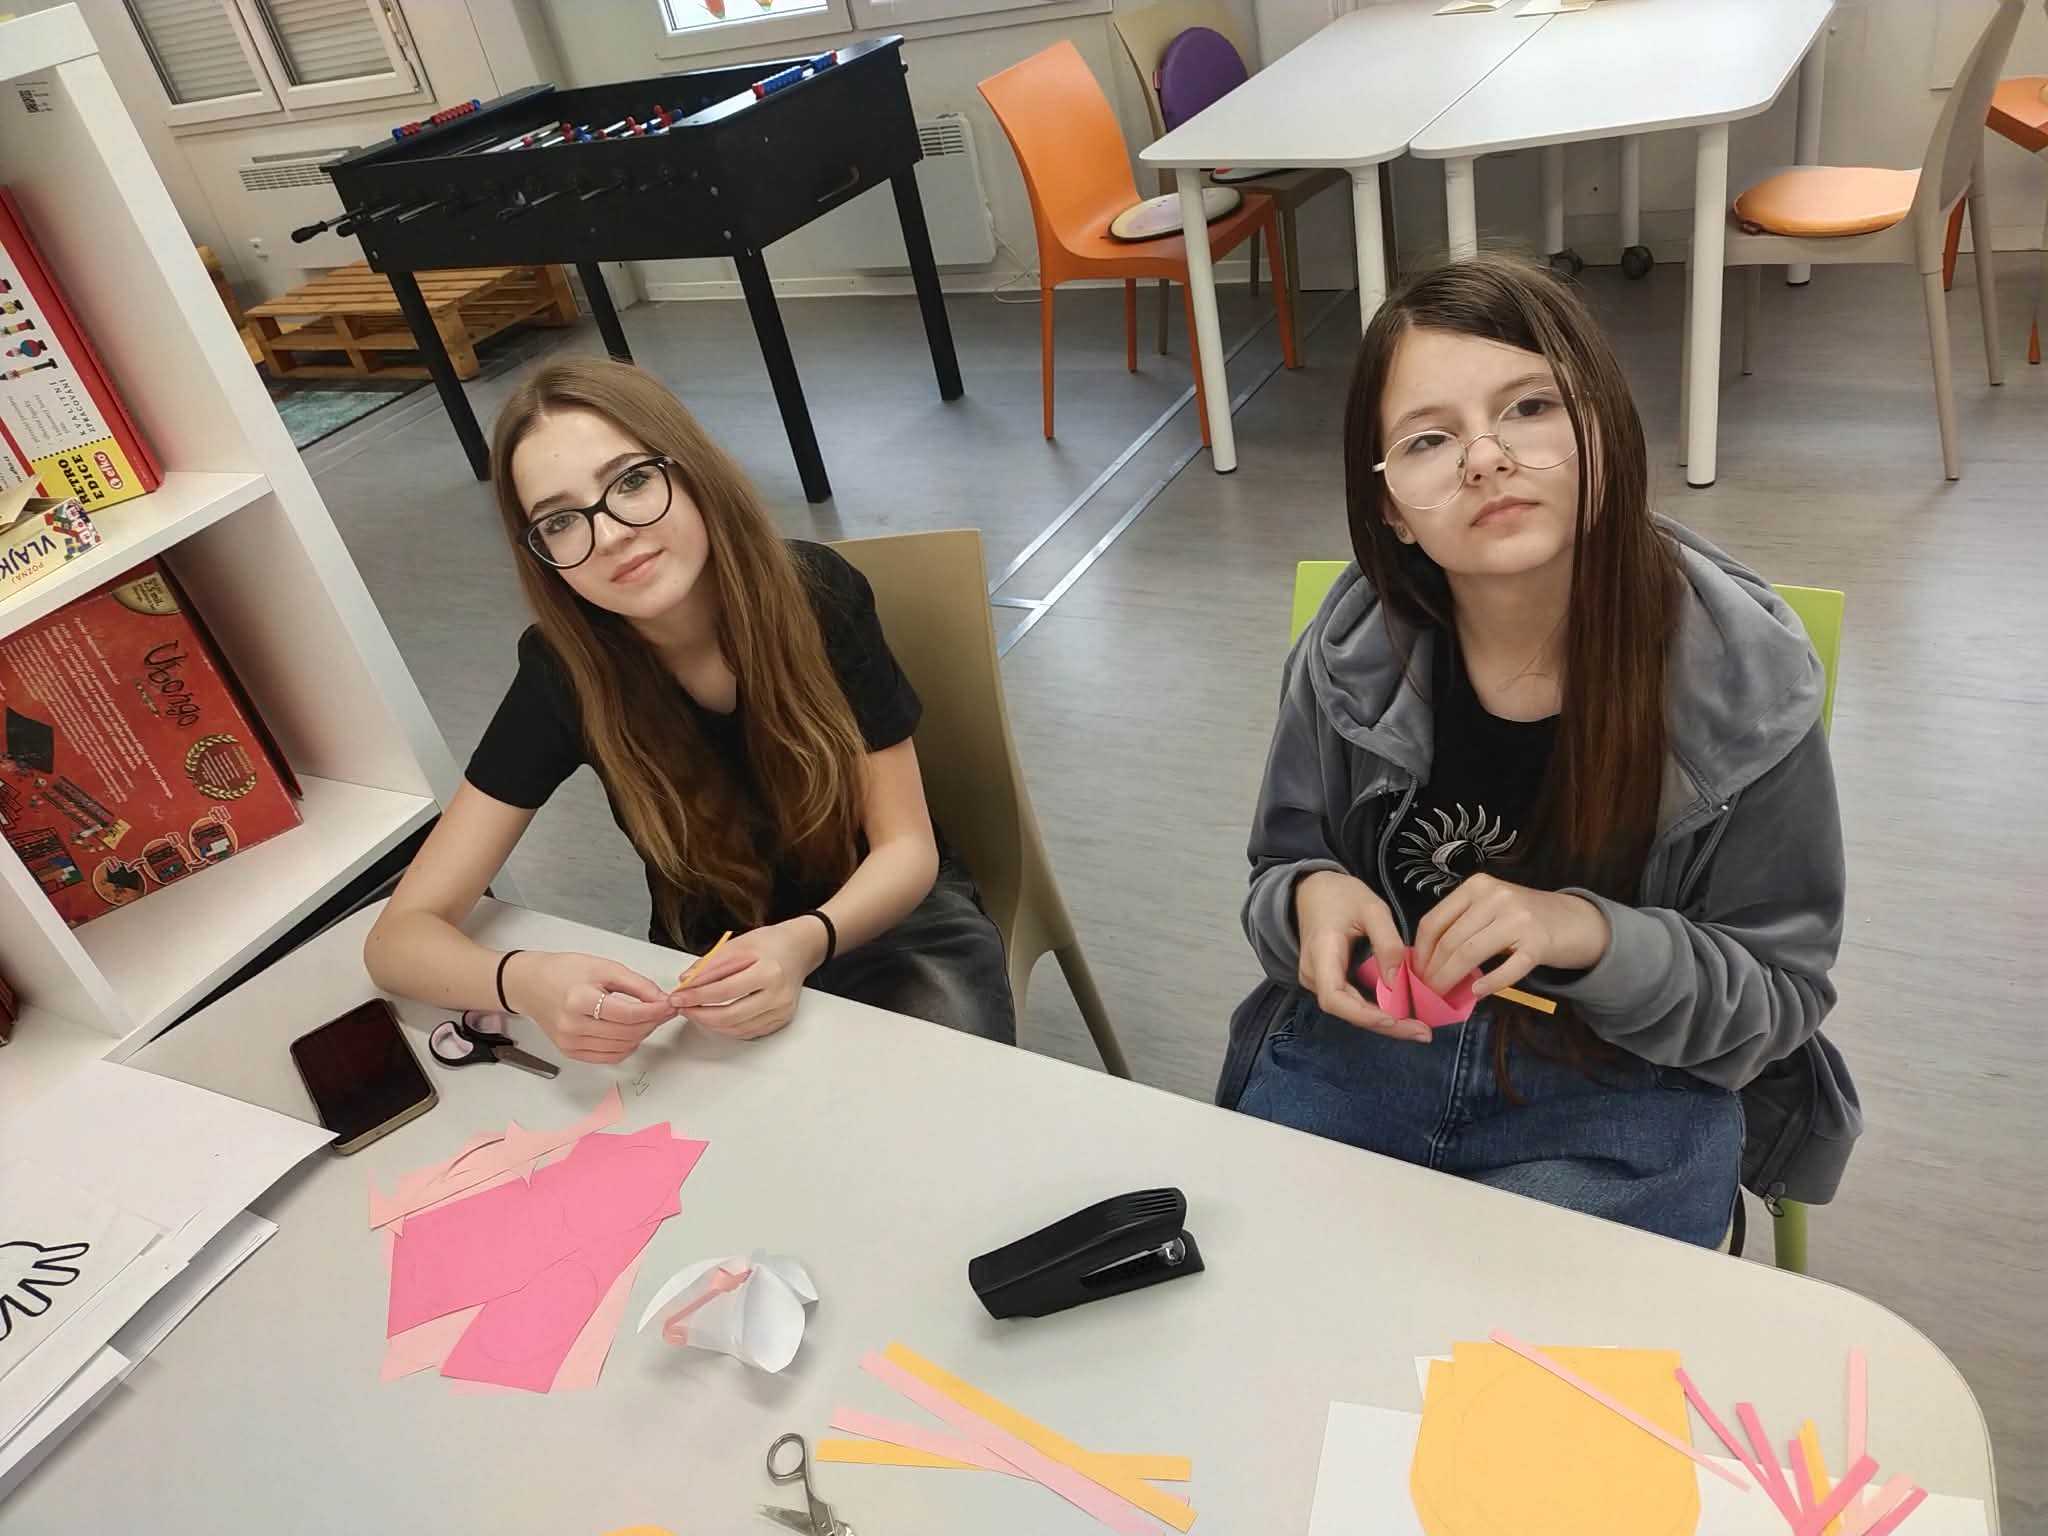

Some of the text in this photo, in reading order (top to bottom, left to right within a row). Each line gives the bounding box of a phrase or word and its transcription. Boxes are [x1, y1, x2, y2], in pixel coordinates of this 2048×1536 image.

[58, 458, 91, 505] RETRO
[72, 454, 104, 499] EDICE
[0, 535, 57, 581] VLAJK
[144, 640, 200, 728] Ubongo
